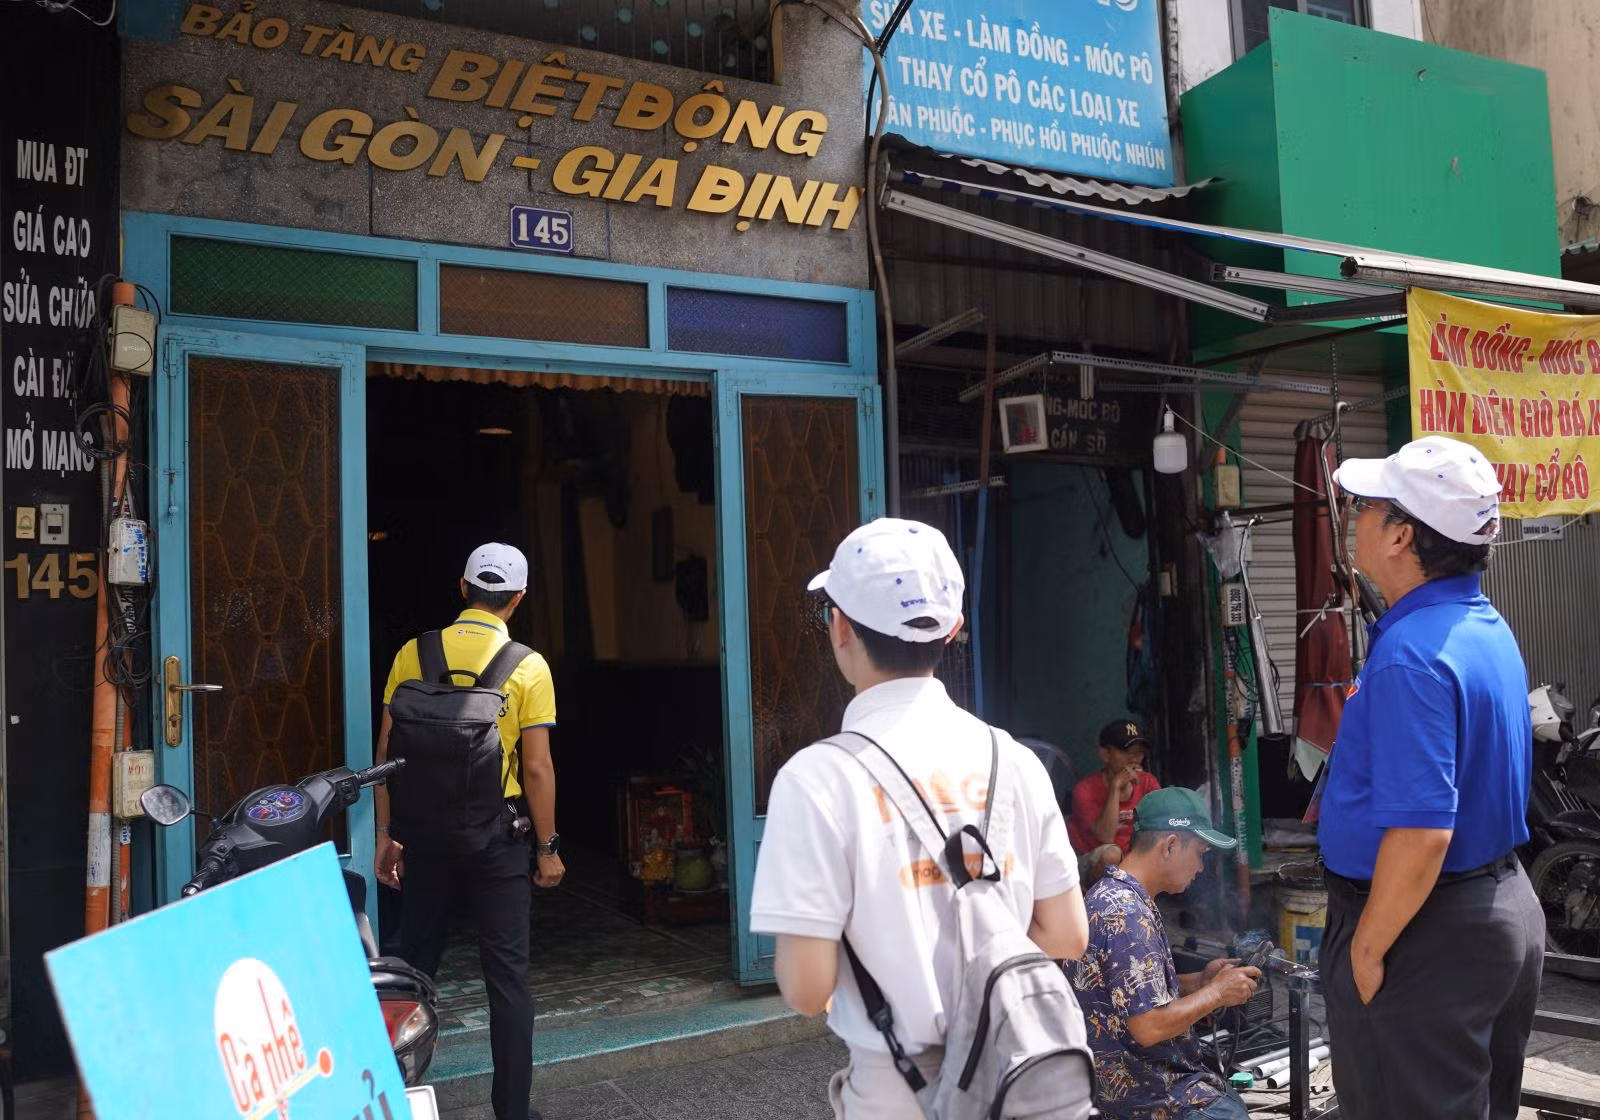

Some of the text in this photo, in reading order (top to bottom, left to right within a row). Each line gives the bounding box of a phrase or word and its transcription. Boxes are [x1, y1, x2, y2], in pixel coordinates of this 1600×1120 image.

[920, 9, 947, 41] XE
[967, 14, 1011, 55] LÀM
[1016, 21, 1069, 67] ĐỒNG
[1084, 42, 1126, 79] MÓC
[1129, 52, 1153, 85] PÔ
[180, 1, 829, 158] BẢO TÀNG BIỆT ĐỘNG
[897, 56, 1141, 128] THAY CỔ PÔ CÁC LOẠI XE
[17, 139, 58, 184] MUA
[126, 78, 864, 232] SÀI GÒN - GIA ĐỊNH
[991, 118, 1035, 149] PHỤC
[1039, 119, 1067, 153] HỒI
[13, 204, 91, 258] GIÁ CAO
[516, 212, 569, 245] 145
[3, 267, 41, 325] SỬA
[13, 347, 45, 398] CÀI
[1420, 380, 1467, 434] HÀN
[1520, 390, 1554, 438] GIÒ
[1557, 391, 1586, 437] ĐÁ
[6, 412, 35, 470] MỞ
[1535, 447, 1561, 502] CỔ
[4, 553, 98, 600] 145
